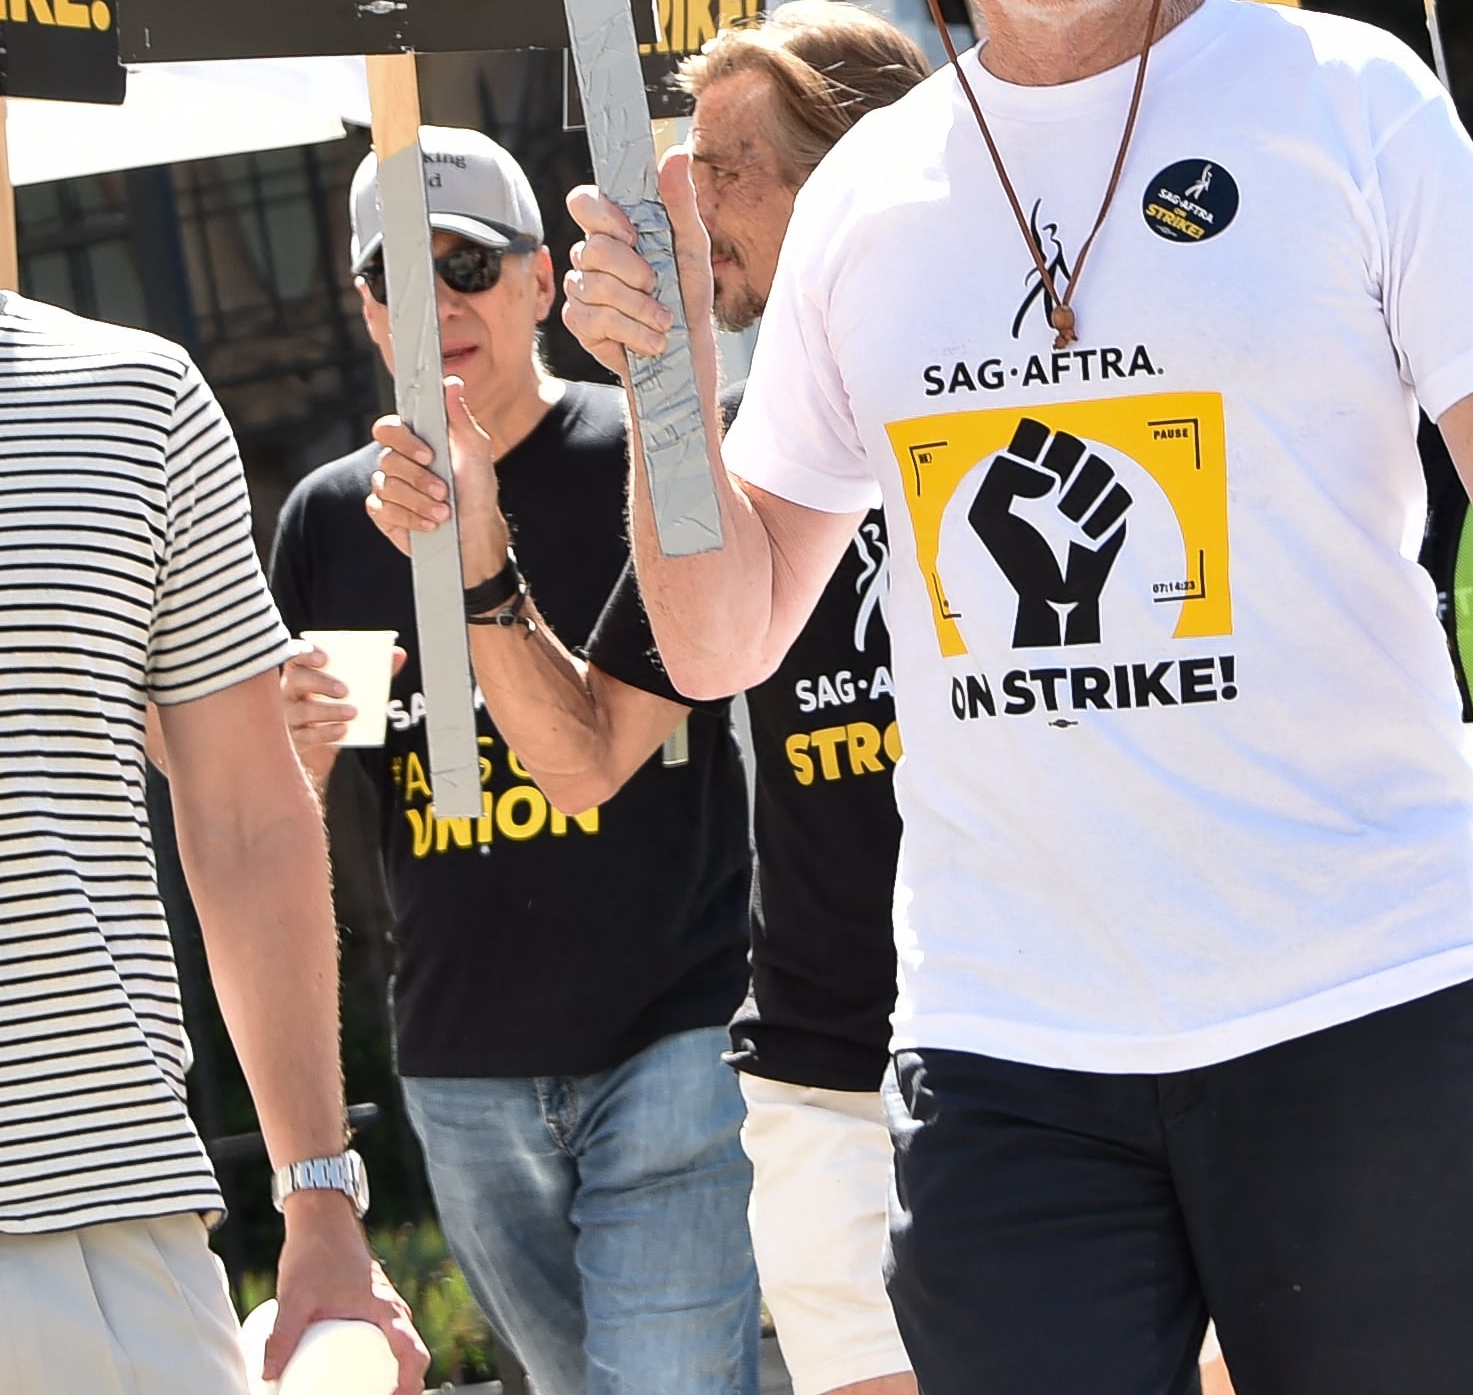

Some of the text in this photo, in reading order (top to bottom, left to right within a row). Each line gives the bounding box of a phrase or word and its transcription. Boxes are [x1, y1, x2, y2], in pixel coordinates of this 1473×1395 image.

[1154, 428, 1188, 440] PAUSE
[951, 655, 1237, 721] ON STRIKE!
